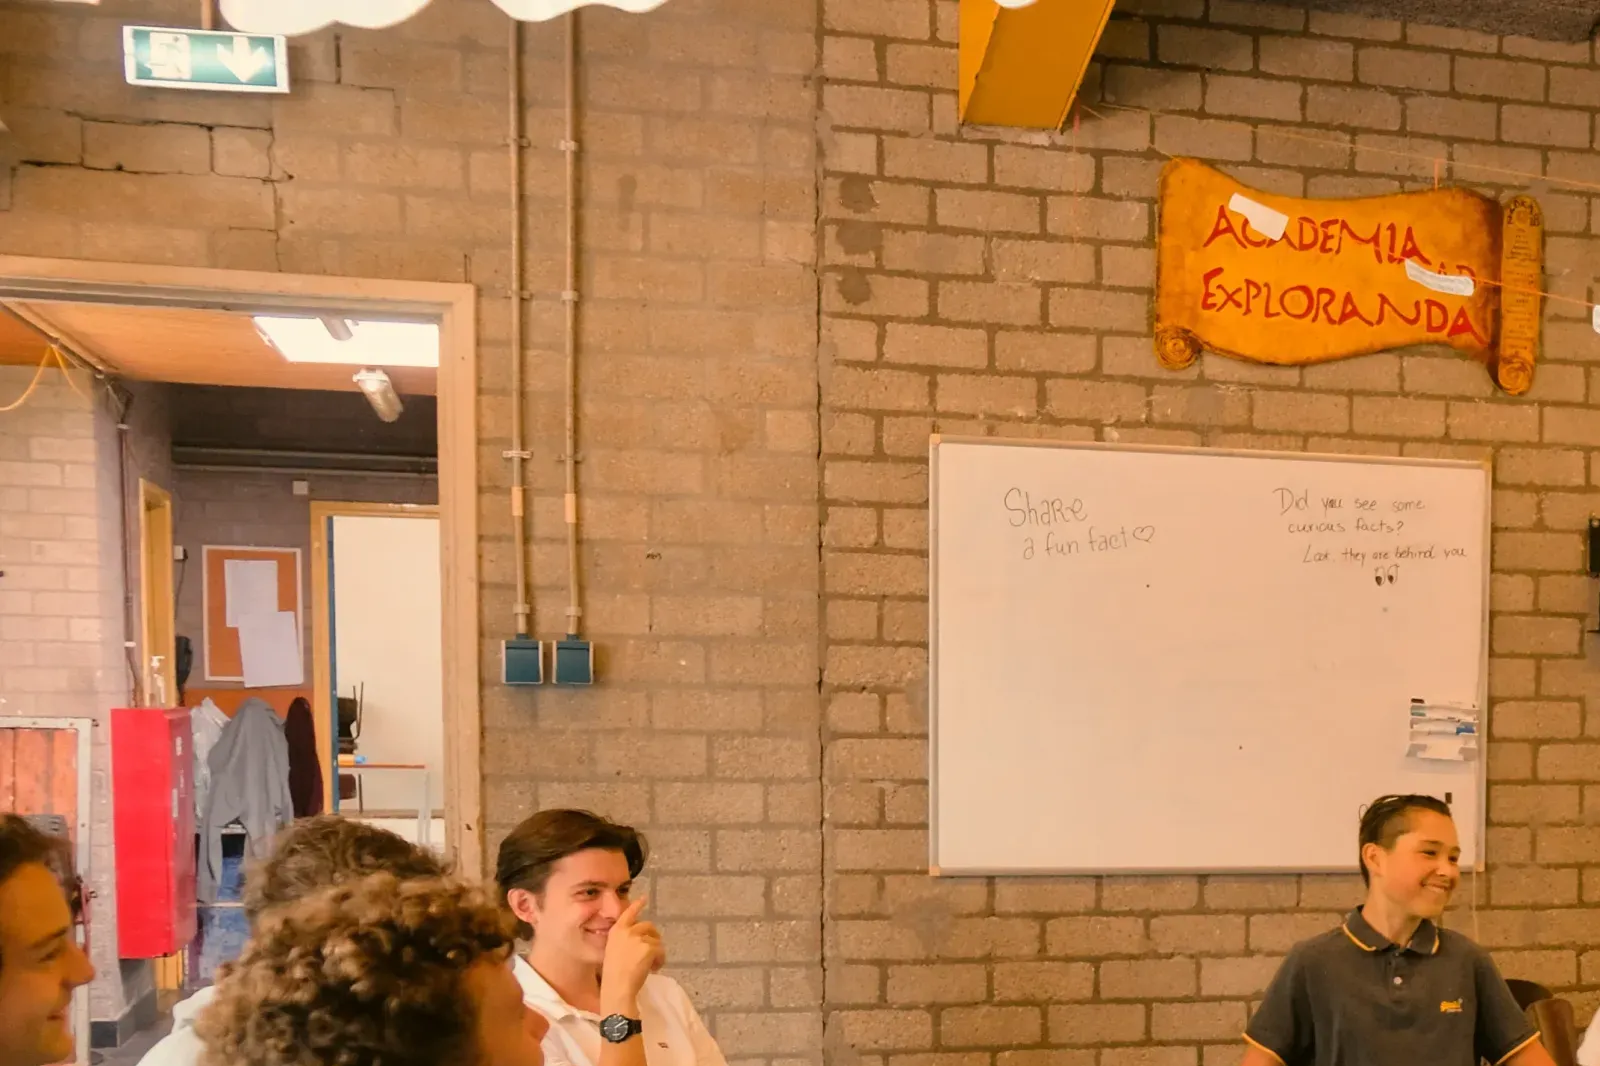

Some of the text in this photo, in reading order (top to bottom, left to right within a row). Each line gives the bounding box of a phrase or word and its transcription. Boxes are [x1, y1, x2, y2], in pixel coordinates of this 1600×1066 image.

[1201, 267, 1489, 346] EXPLORANDA
[1272, 487, 1425, 517] Did you see some
[1288, 517, 1404, 536] curious facts?
[1023, 526, 1128, 560] a fun fact
[1341, 547, 1366, 567] they
[1372, 551, 1389, 560] are
[1394, 544, 1436, 560] behind
[1444, 548, 1467, 560] you
